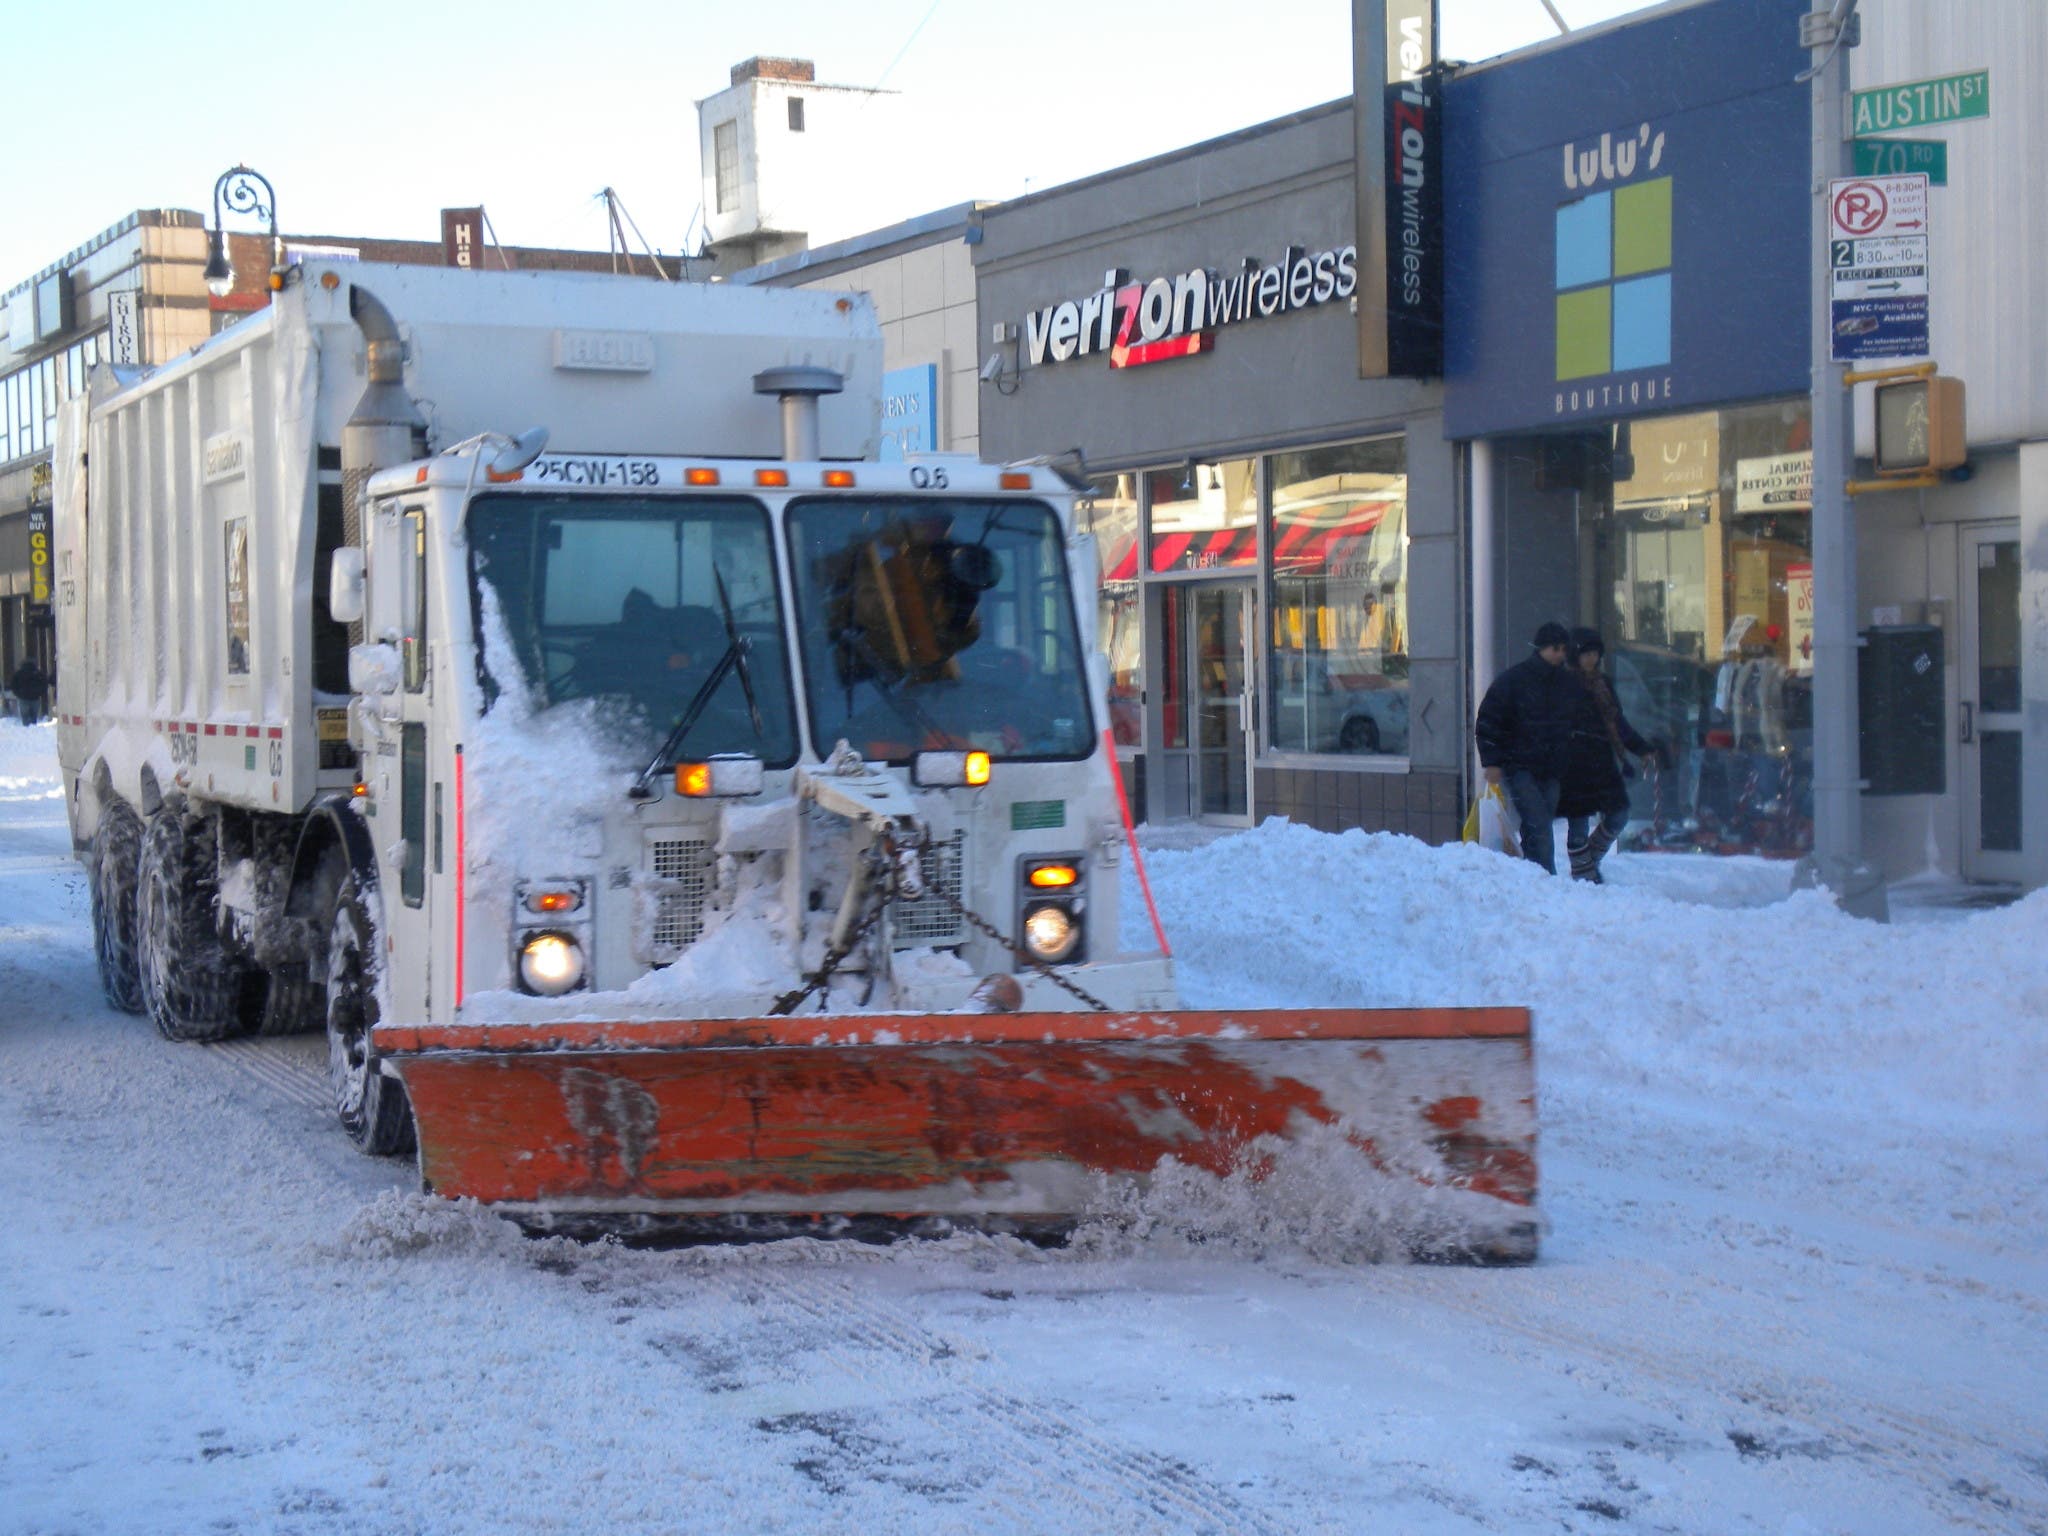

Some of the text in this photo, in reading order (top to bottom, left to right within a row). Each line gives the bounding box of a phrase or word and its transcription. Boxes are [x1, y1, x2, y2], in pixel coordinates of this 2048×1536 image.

[1855, 76, 1983, 132] AUSTIN ST
[1395, 16, 1430, 304] verizon wireless
[1866, 143, 1933, 177] 70 RD
[1893, 195, 1921, 204] EXCEPT
[1893, 207, 1922, 215] SUNDAY
[1885, 238, 1921, 247] PARKING
[1836, 242, 1850, 266] 2
[1841, 265, 1919, 280] EXCEPT SUNDAY
[1027, 246, 1356, 369] verizon wireless
[1853, 301, 1925, 312] NYC Parking Card
[1883, 312, 1925, 322] Available
[1556, 377, 1671, 413] BOUTIQUE
[534, 461, 659, 486] 25CW-158
[29, 521, 47, 530] BUY
[31, 513, 45, 522] WE
[31, 532, 48, 599] GOLD
